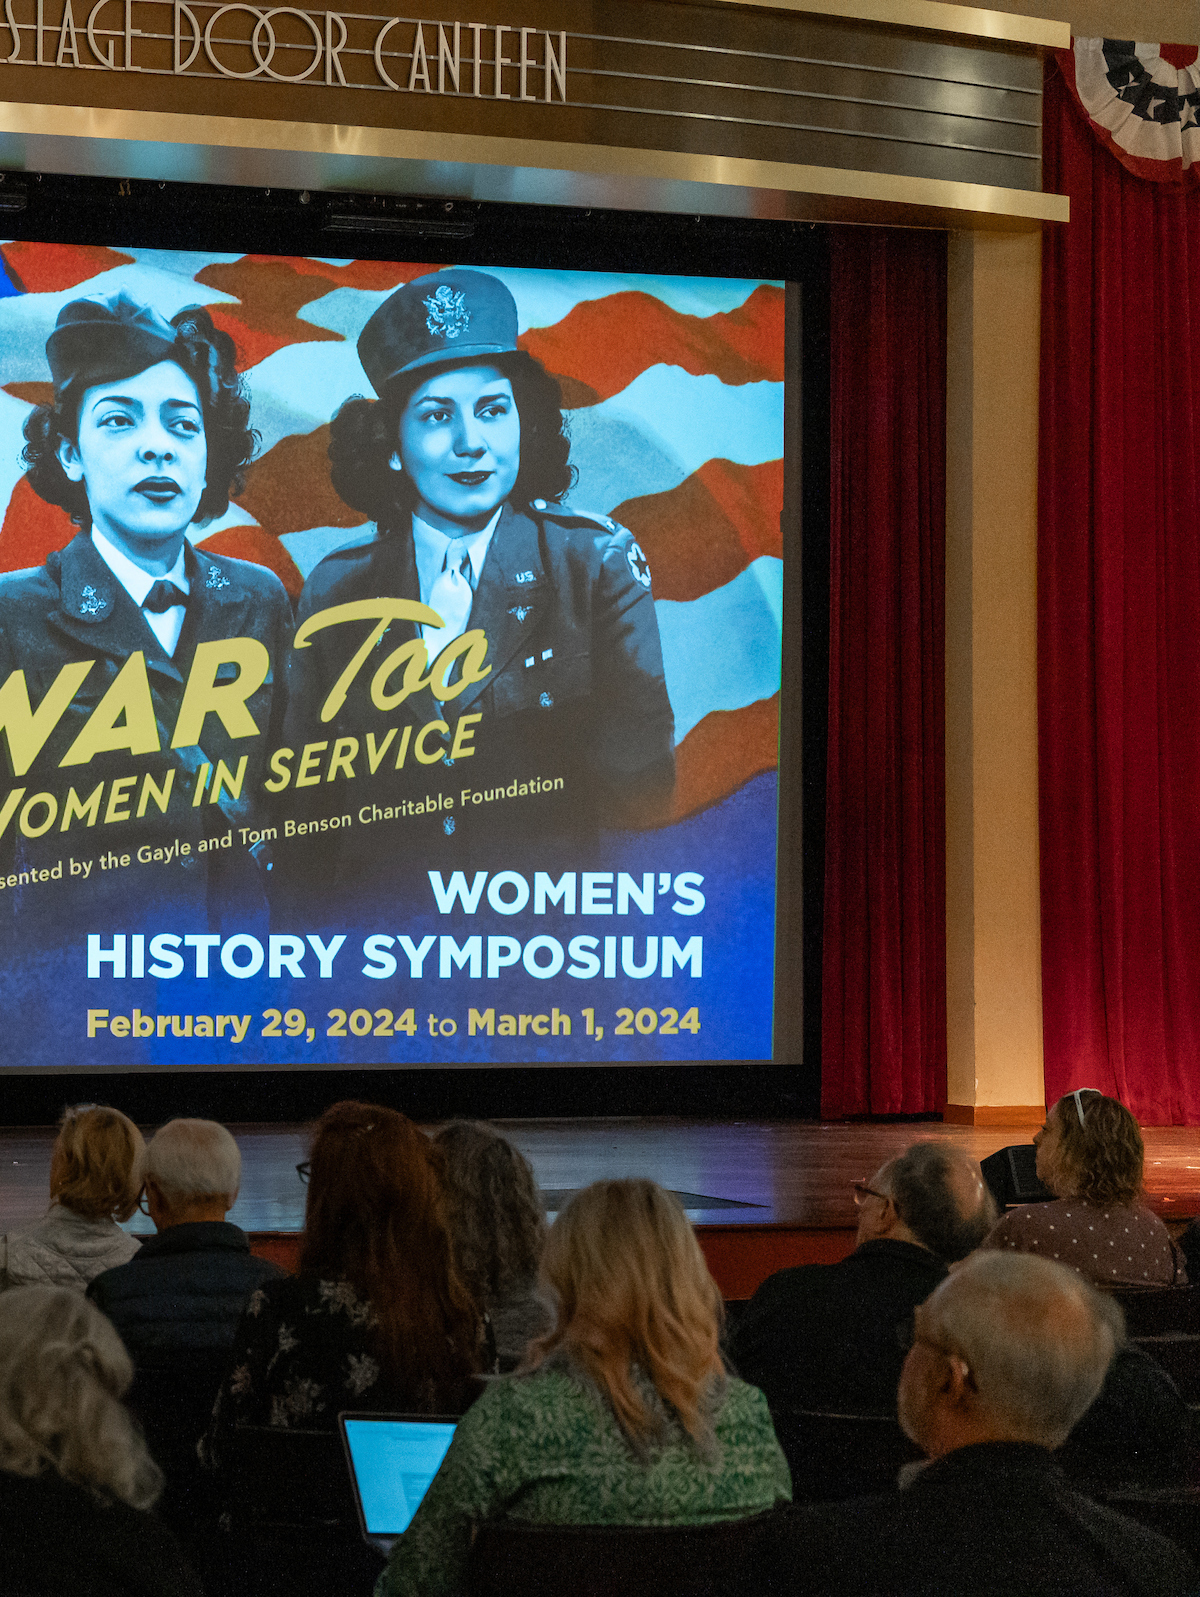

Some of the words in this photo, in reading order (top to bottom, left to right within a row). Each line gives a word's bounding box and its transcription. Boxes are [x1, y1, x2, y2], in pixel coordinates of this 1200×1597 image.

[174, 0, 349, 87] DOOR
[374, 16, 567, 103] CANTEEN
[292, 597, 493, 723] Too
[191, 755, 248, 807] IN
[264, 712, 483, 793] SERVICE
[69, 857, 93, 879] by
[99, 851, 131, 870] the
[136, 839, 191, 864] Gayle
[197, 830, 232, 853] and
[238, 827, 278, 845] Tom
[284, 814, 352, 838] Benson
[358, 793, 455, 825] Charitable
[460, 776, 565, 807] Foundation
[428, 870, 706, 916] WOMEN'S
[85, 933, 347, 980] HISTORY
[361, 933, 705, 981] SYMPOSIUM
[86, 1007, 252, 1043] February
[260, 1007, 317, 1042] 29,
[325, 1007, 419, 1038] 2024
[427, 1011, 459, 1038] to
[467, 1006, 572, 1037] March
[581, 1007, 604, 1041] 1,
[614, 1007, 702, 1036] 2024
